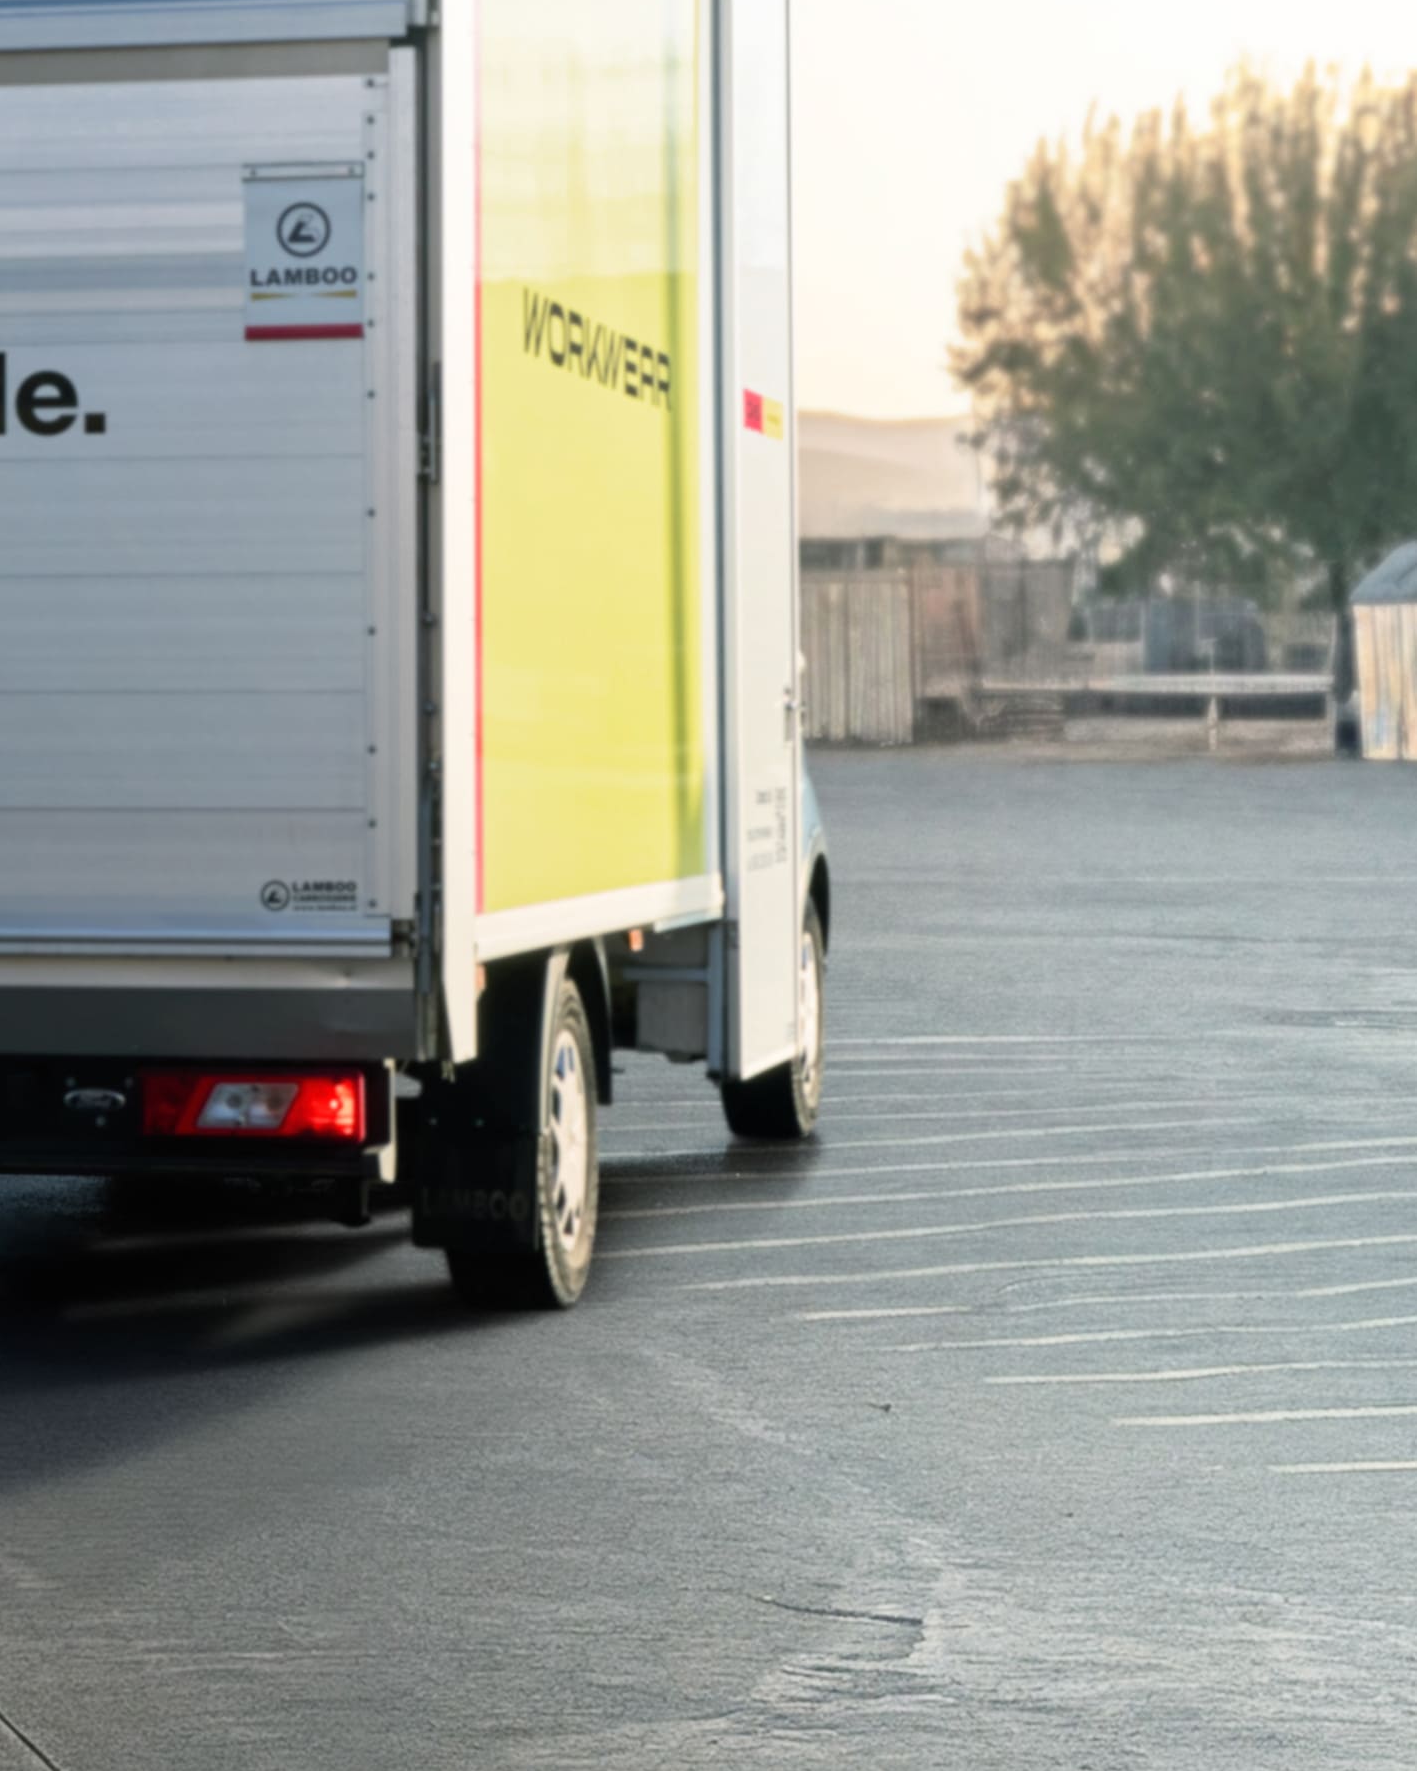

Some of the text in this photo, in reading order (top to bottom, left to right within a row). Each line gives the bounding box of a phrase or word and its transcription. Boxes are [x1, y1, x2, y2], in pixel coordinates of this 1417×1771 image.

[250, 266, 357, 287] LAMBOO
[523, 286, 671, 413] WORKWEAR
[291, 881, 357, 892] LAMBOO
[421, 1186, 529, 1221] LMBOO
